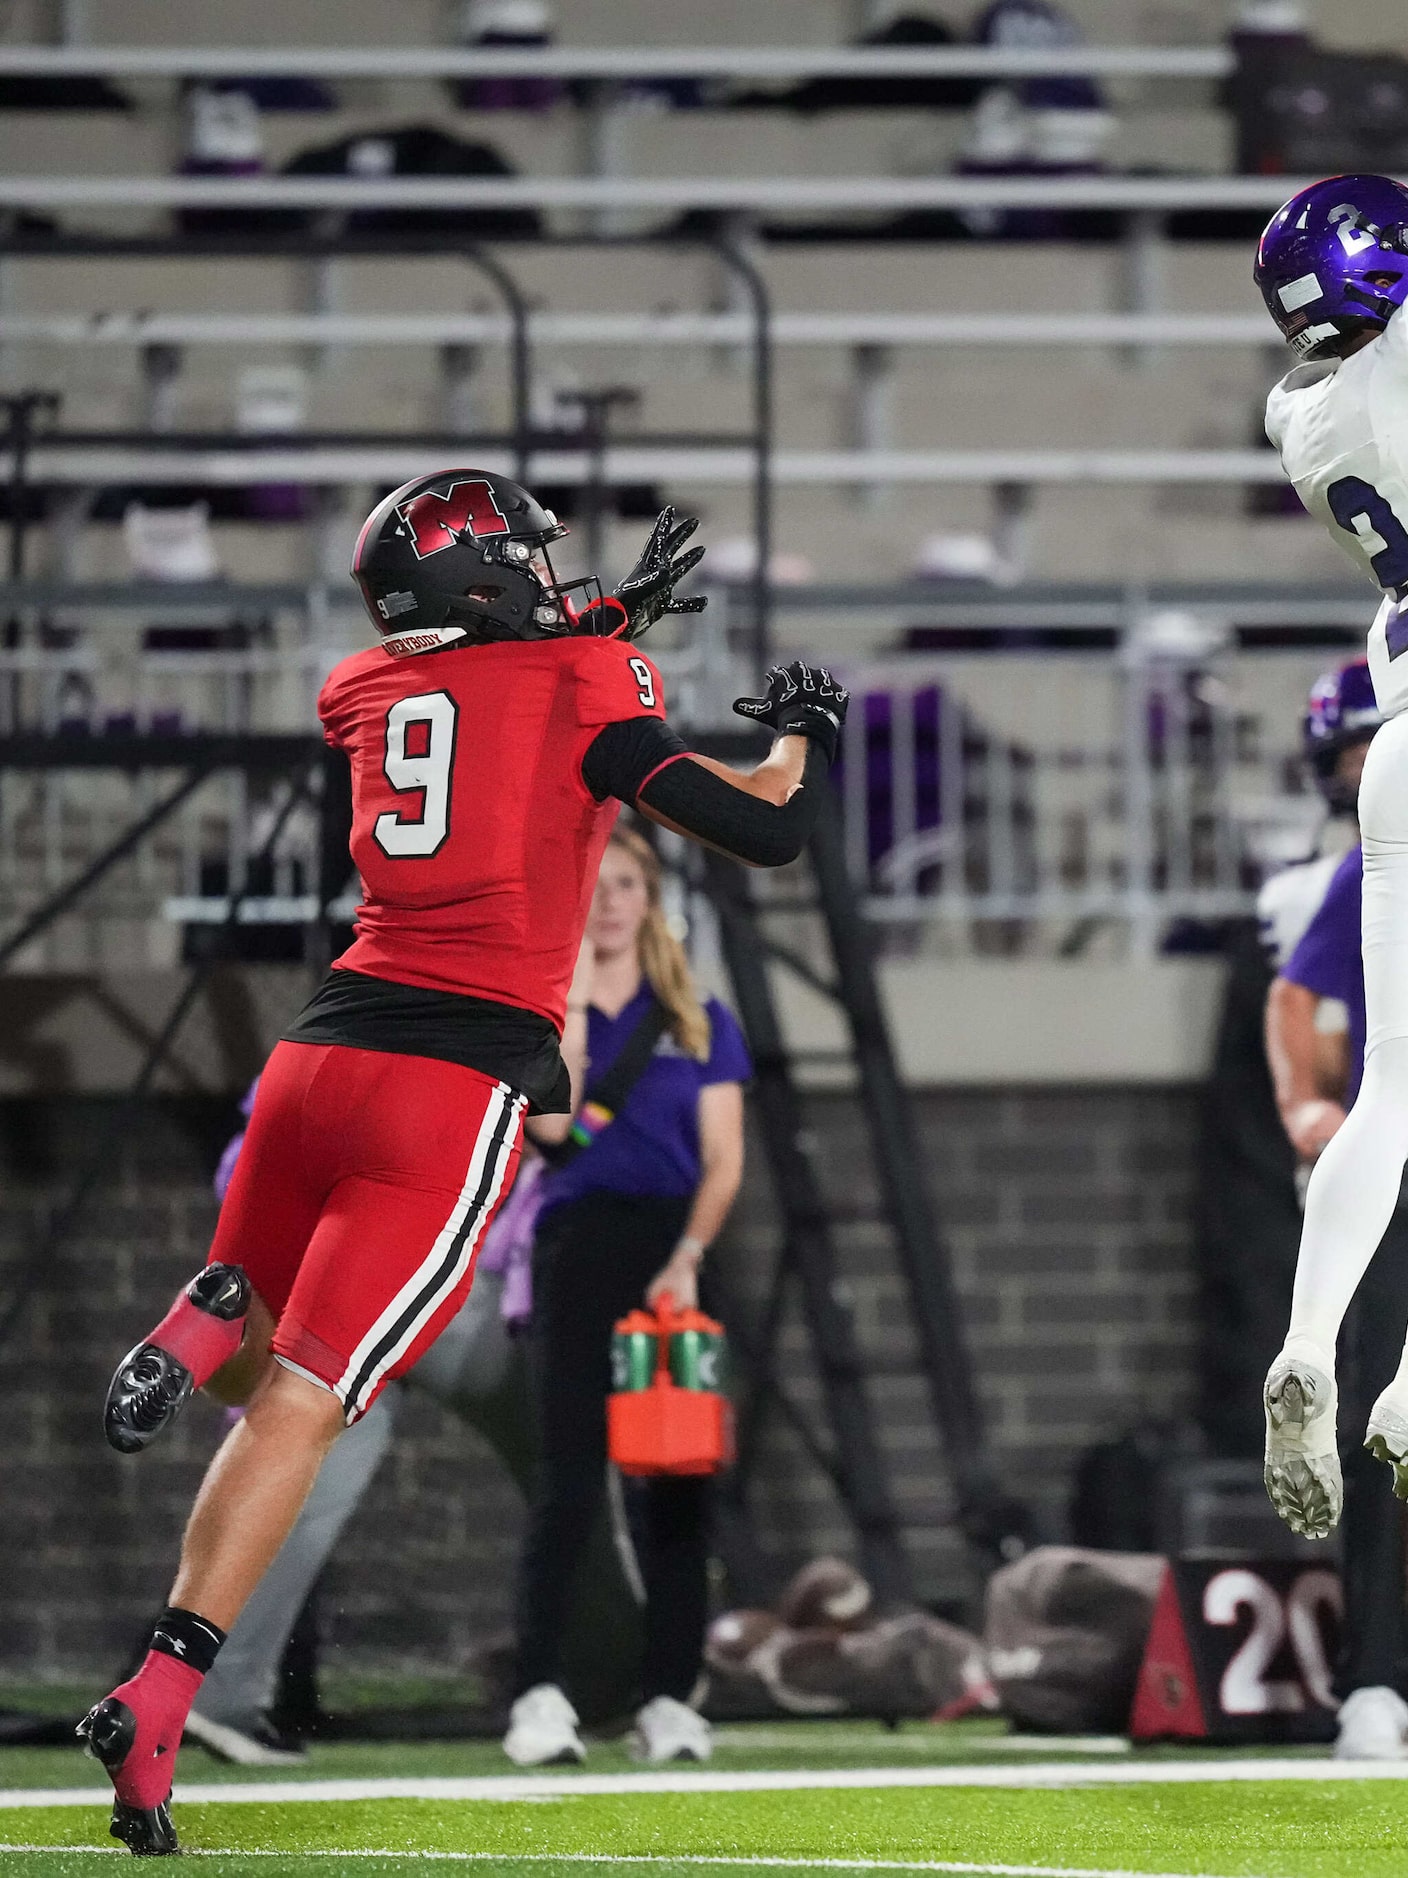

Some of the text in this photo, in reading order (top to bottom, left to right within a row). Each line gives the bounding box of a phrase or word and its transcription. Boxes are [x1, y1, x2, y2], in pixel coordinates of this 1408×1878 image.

[1327, 203, 1376, 257] 2
[395, 480, 510, 560] M
[377, 599, 390, 620] 9
[629, 657, 656, 708] 9
[372, 688, 460, 859] 9
